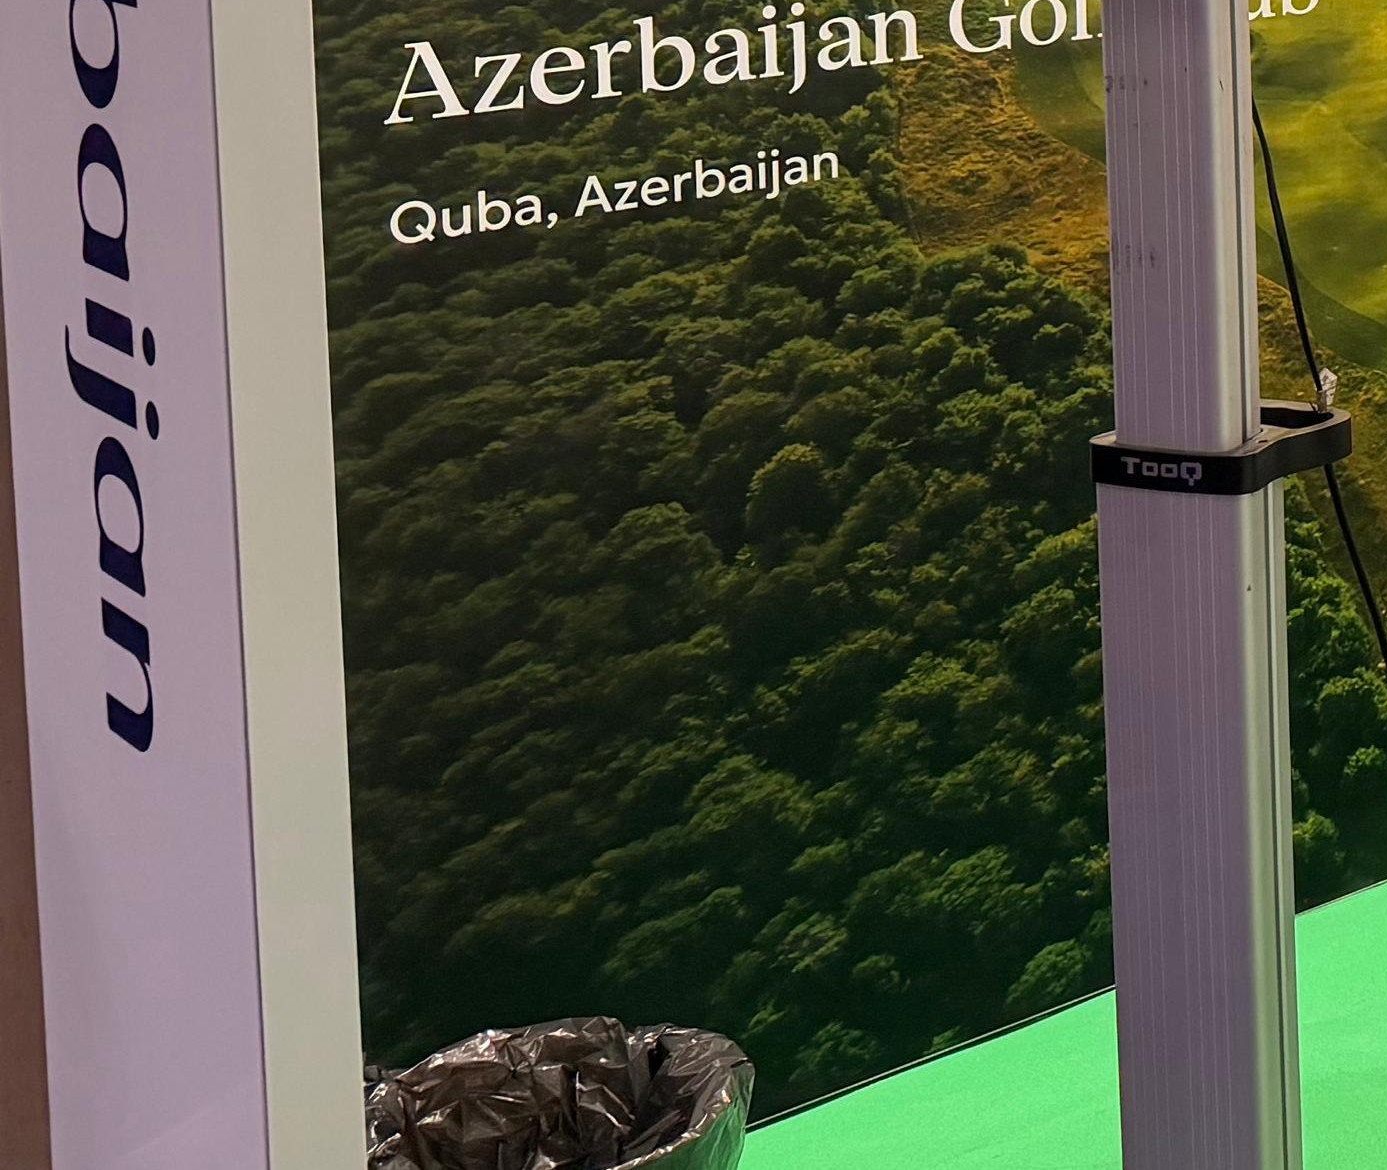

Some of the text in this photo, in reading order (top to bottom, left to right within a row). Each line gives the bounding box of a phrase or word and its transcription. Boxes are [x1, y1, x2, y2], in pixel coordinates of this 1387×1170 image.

[383, 2, 925, 126] Azerbaijan
[389, 148, 840, 245] Quba, Azerbaijan
